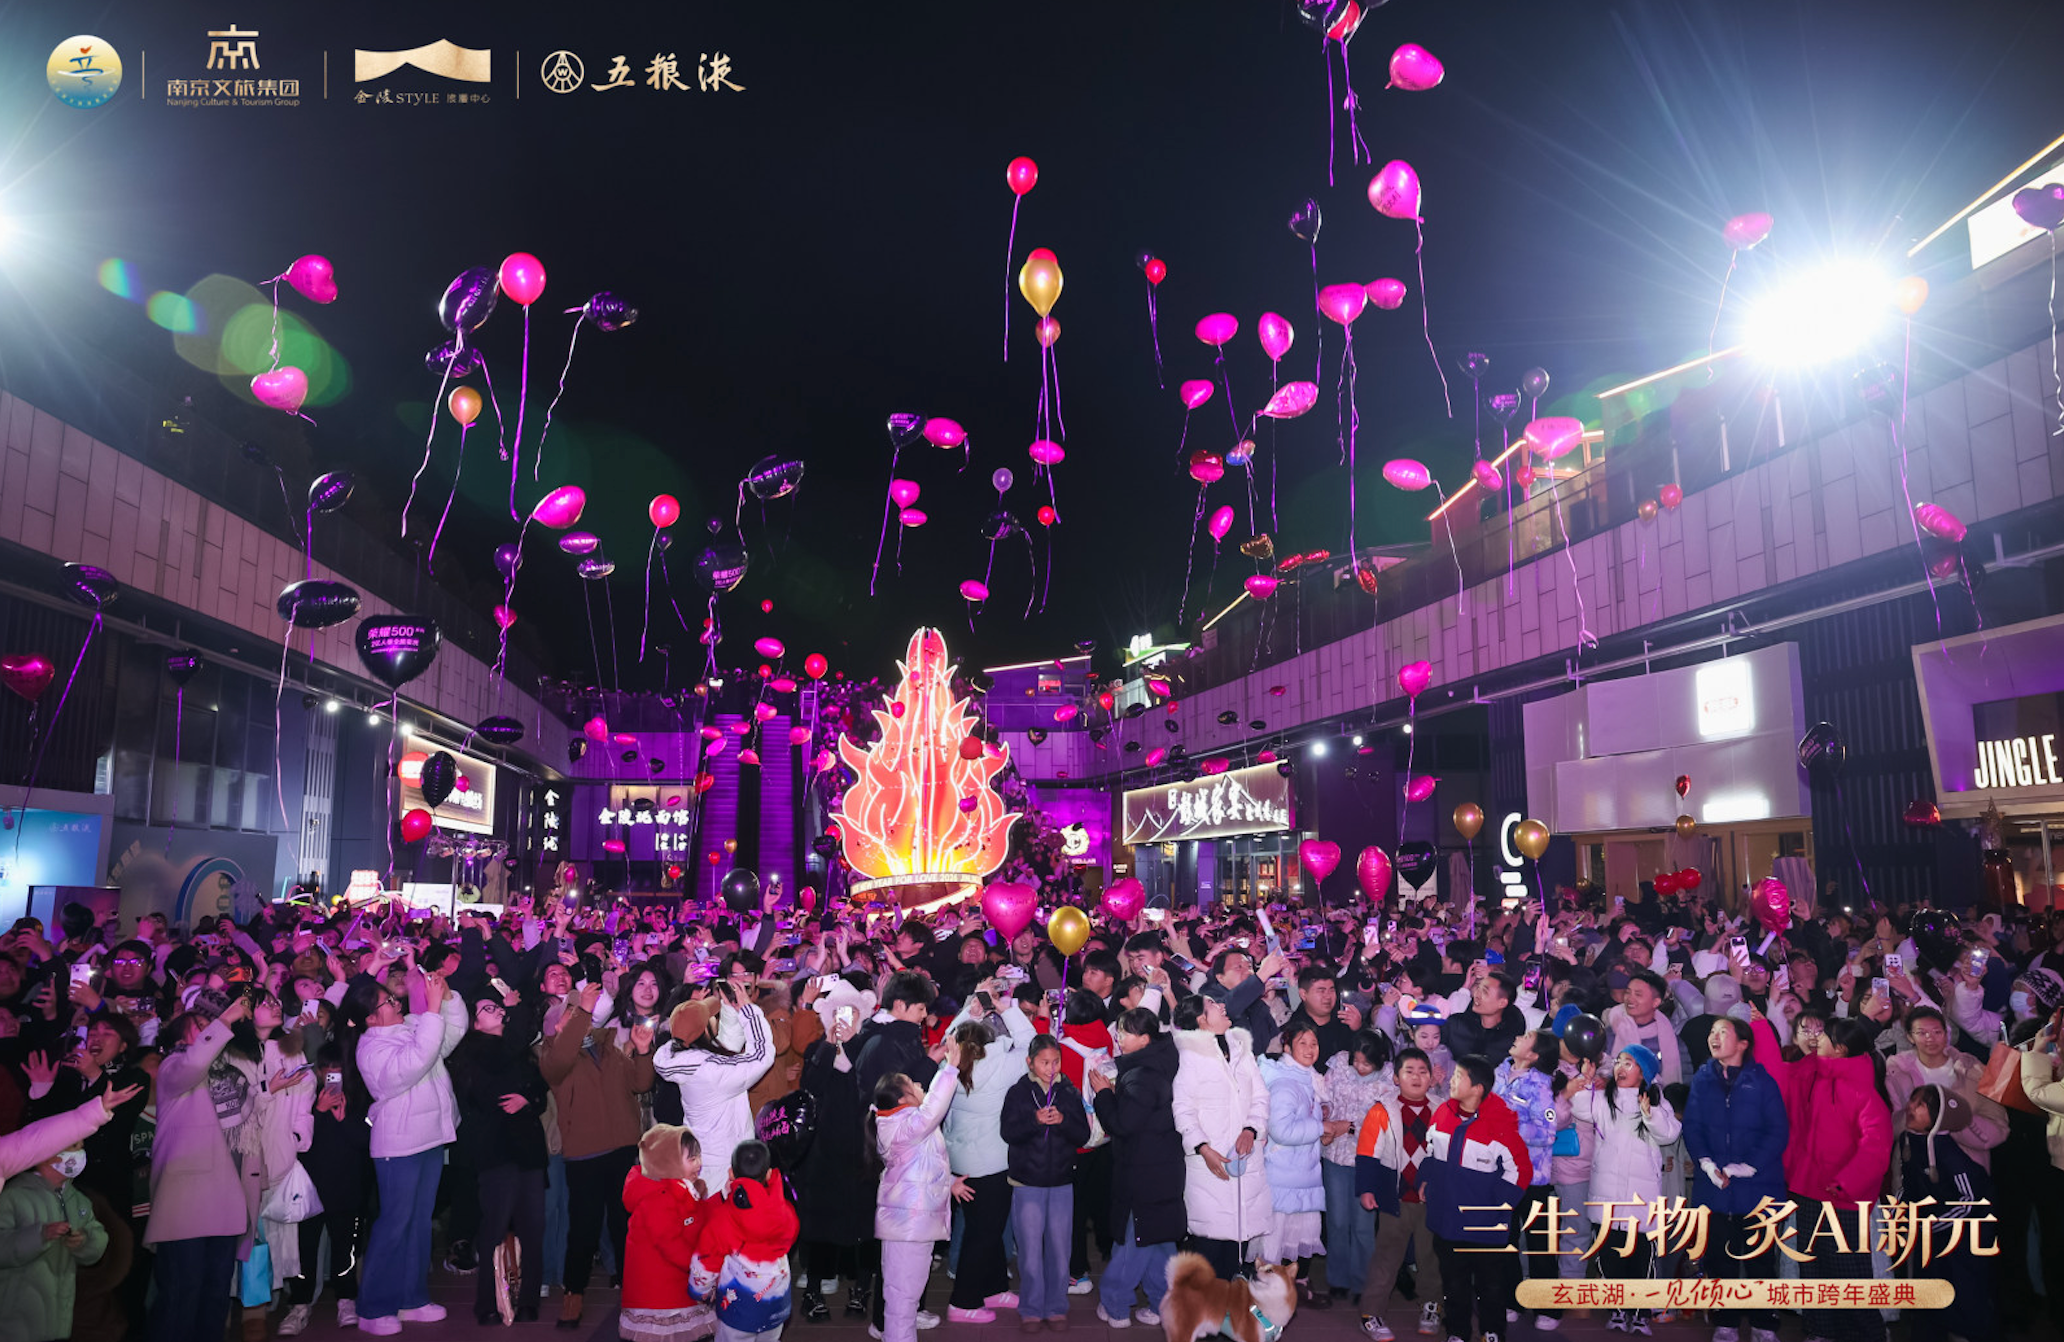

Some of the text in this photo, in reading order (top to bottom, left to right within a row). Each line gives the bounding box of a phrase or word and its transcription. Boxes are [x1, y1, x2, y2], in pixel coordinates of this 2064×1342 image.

[1974, 734, 2063, 788] JINGLE
[896, 874, 913, 886] FOR
[915, 873, 938, 885] LOVE
